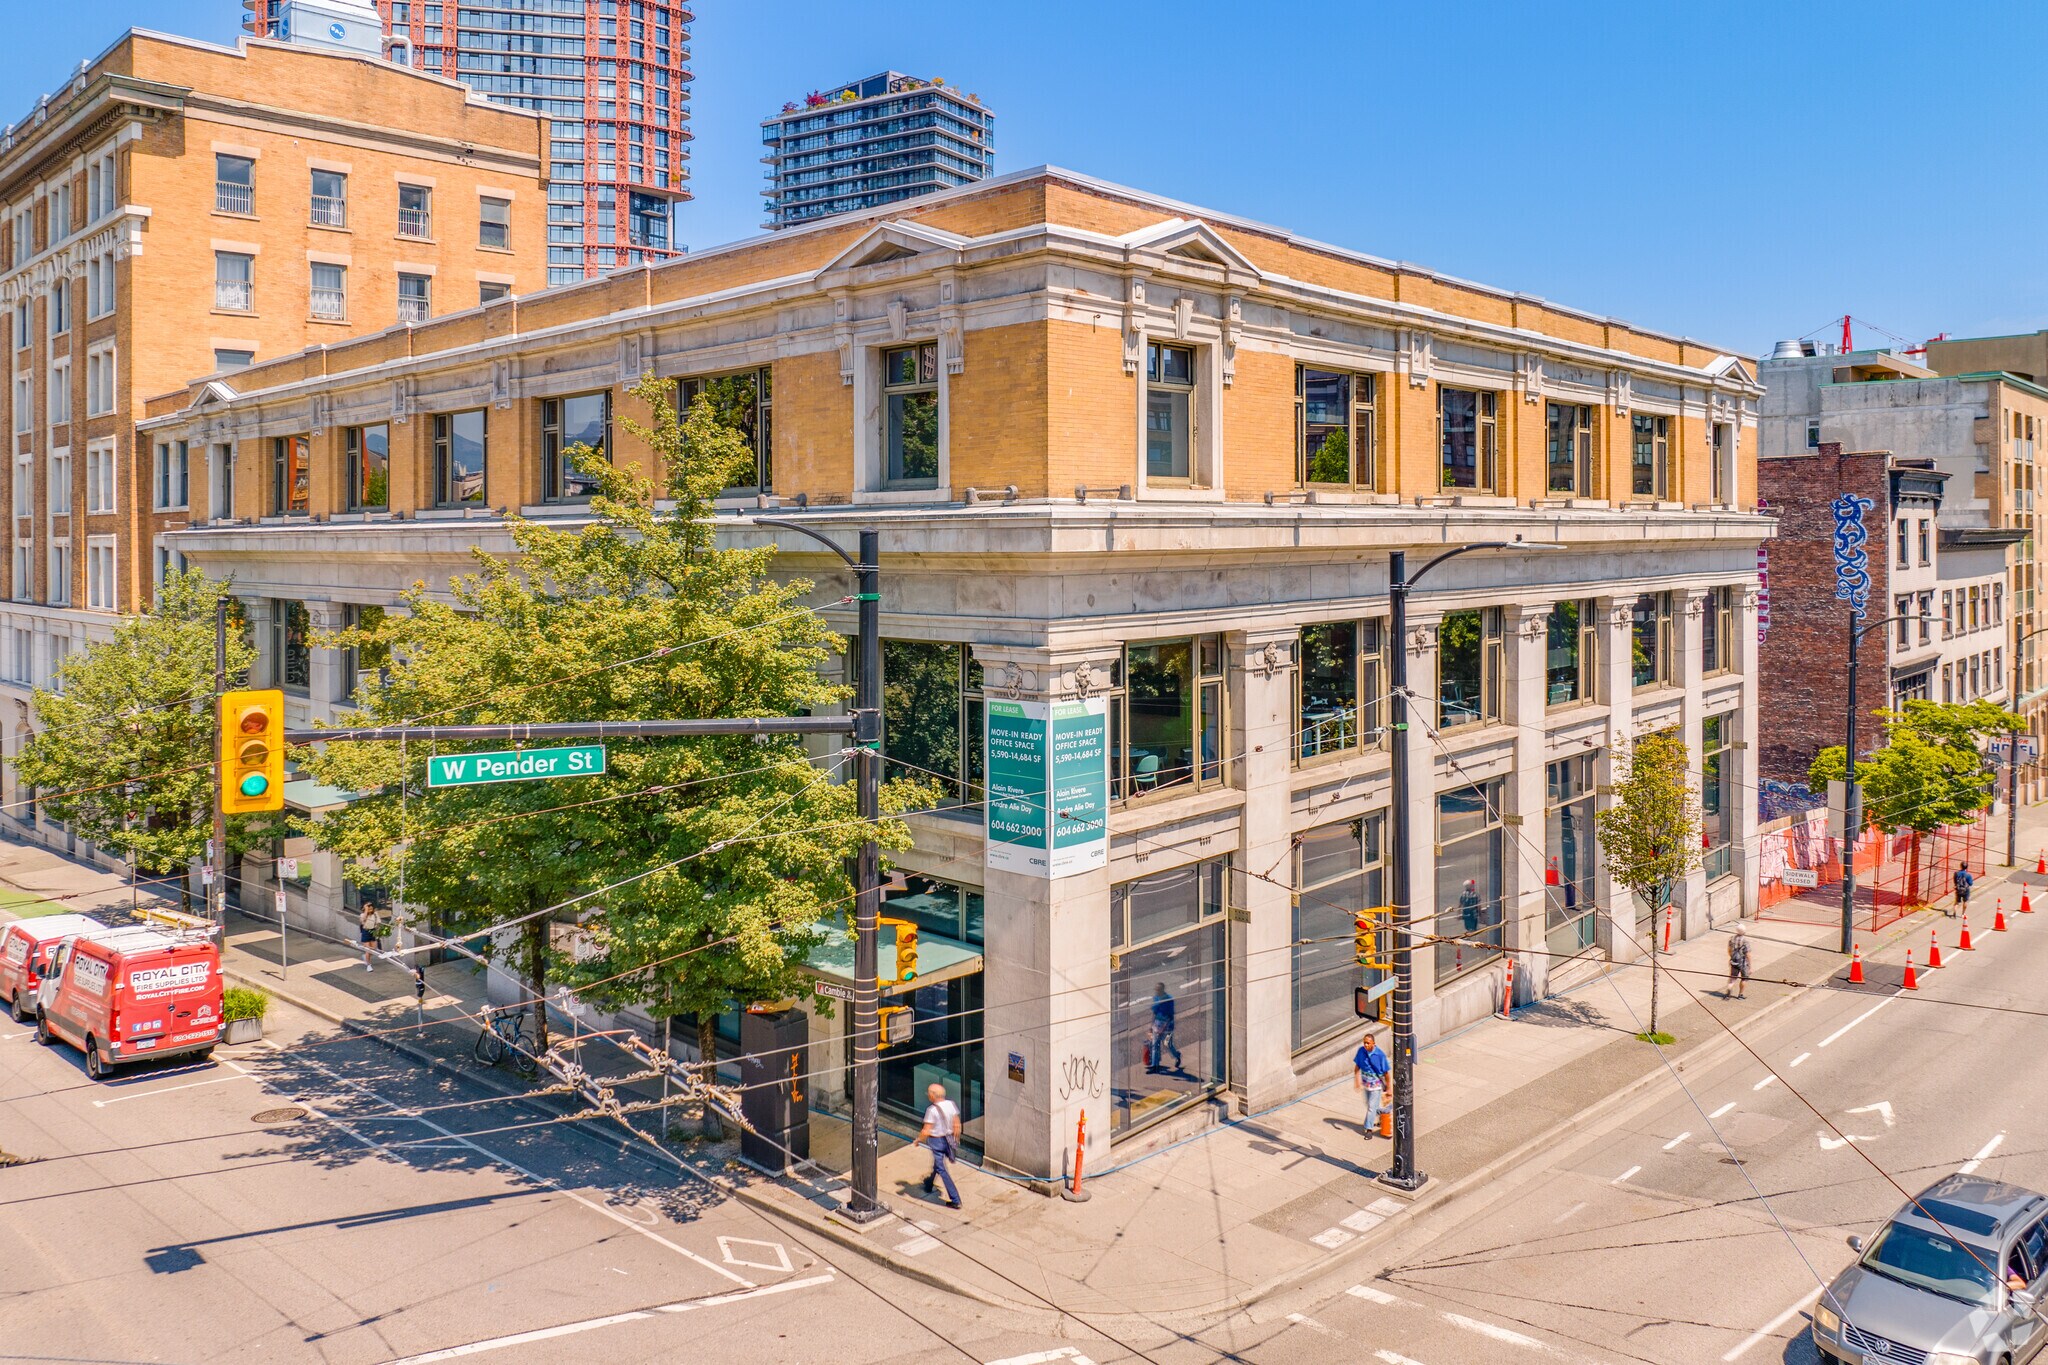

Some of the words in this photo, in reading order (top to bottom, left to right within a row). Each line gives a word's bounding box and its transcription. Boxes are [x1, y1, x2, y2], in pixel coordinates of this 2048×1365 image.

[991, 704, 1002, 713] FOR
[1003, 705, 1019, 714] LEASE
[1054, 708, 1066, 716] FOR
[1067, 706, 1083, 715] LEASE
[990, 728, 1019, 738] MOVE-IN
[1020, 732, 1043, 741] READY
[1055, 730, 1083, 741] MOVE-IN
[1084, 727, 1103, 737] READY
[990, 738, 1013, 748] OFFICE
[1014, 741, 1035, 750] SPACE
[1055, 741, 1078, 751] OFFICE
[1078, 737, 1097, 747] SPACE
[991, 749, 1032, 762] 5,590-14,684
[1033, 754, 1042, 763] SF
[1055, 750, 1093, 764] 5,590-14,684
[1094, 748, 1102, 757] SF
[441, 760, 467, 780] W
[476, 755, 559, 778] Pender
[567, 751, 593, 771] St
[991, 783, 1006, 792] Alain
[1056, 789, 1070, 798] Alain
[1020, 804, 1033, 814] Day
[1084, 802, 1096, 810] Day
[991, 819, 1005, 831] 604
[1005, 821, 1020, 833] 662
[1021, 824, 1042, 837] 3000
[1056, 826, 1071, 837] 604
[1071, 823, 1085, 834] 662
[1086, 818, 1104, 831] 3000
[1090, 848, 1104, 858] CBRE
[1028, 857, 1047, 867] CBRE
[1785, 871, 1815, 879] SIDEWALK
[1789, 877, 1811, 885] CLOSED
[132, 969, 177, 983] ROYAL
[181, 963, 209, 976] CITY
[136, 983, 153, 991] FIRE
[155, 978, 189, 989] SUPPLIES
[824, 985, 846, 998] Cambie
